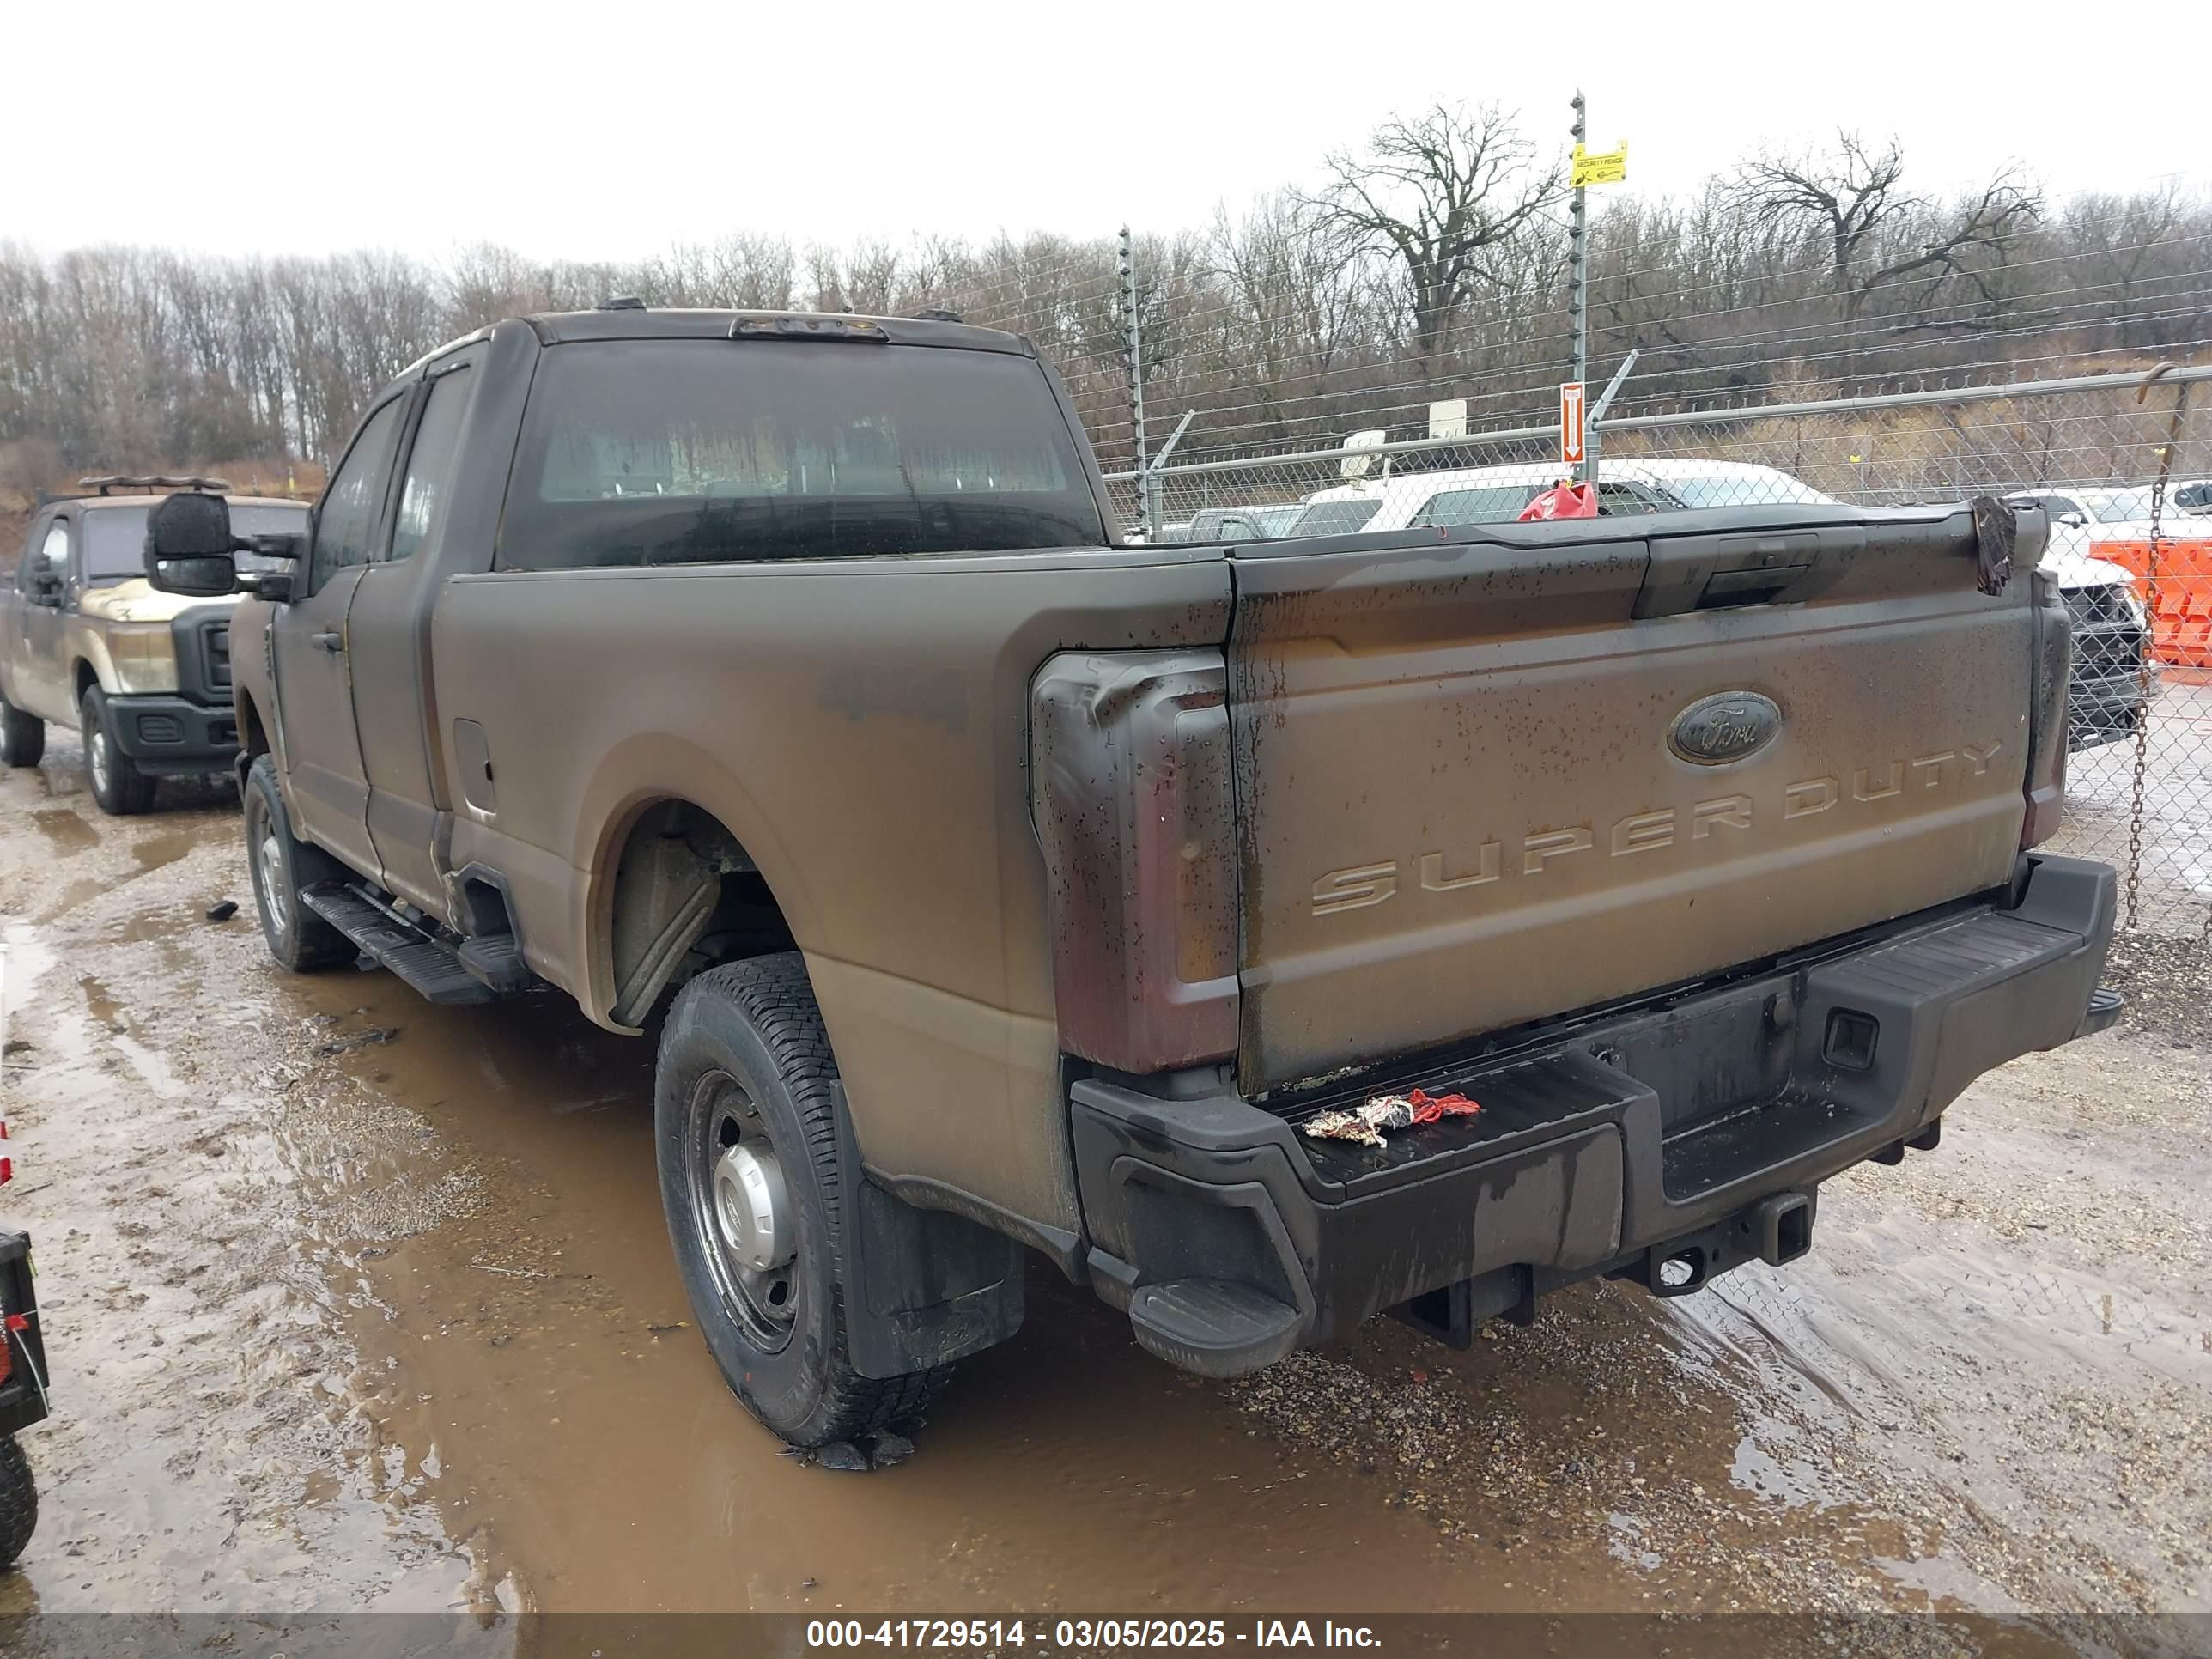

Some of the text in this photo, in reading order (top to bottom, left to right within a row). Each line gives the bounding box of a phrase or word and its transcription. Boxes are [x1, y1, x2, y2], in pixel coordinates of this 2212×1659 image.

[1701, 707, 1762, 750] Ford
[1311, 738, 2002, 917] SUPER DUTY
